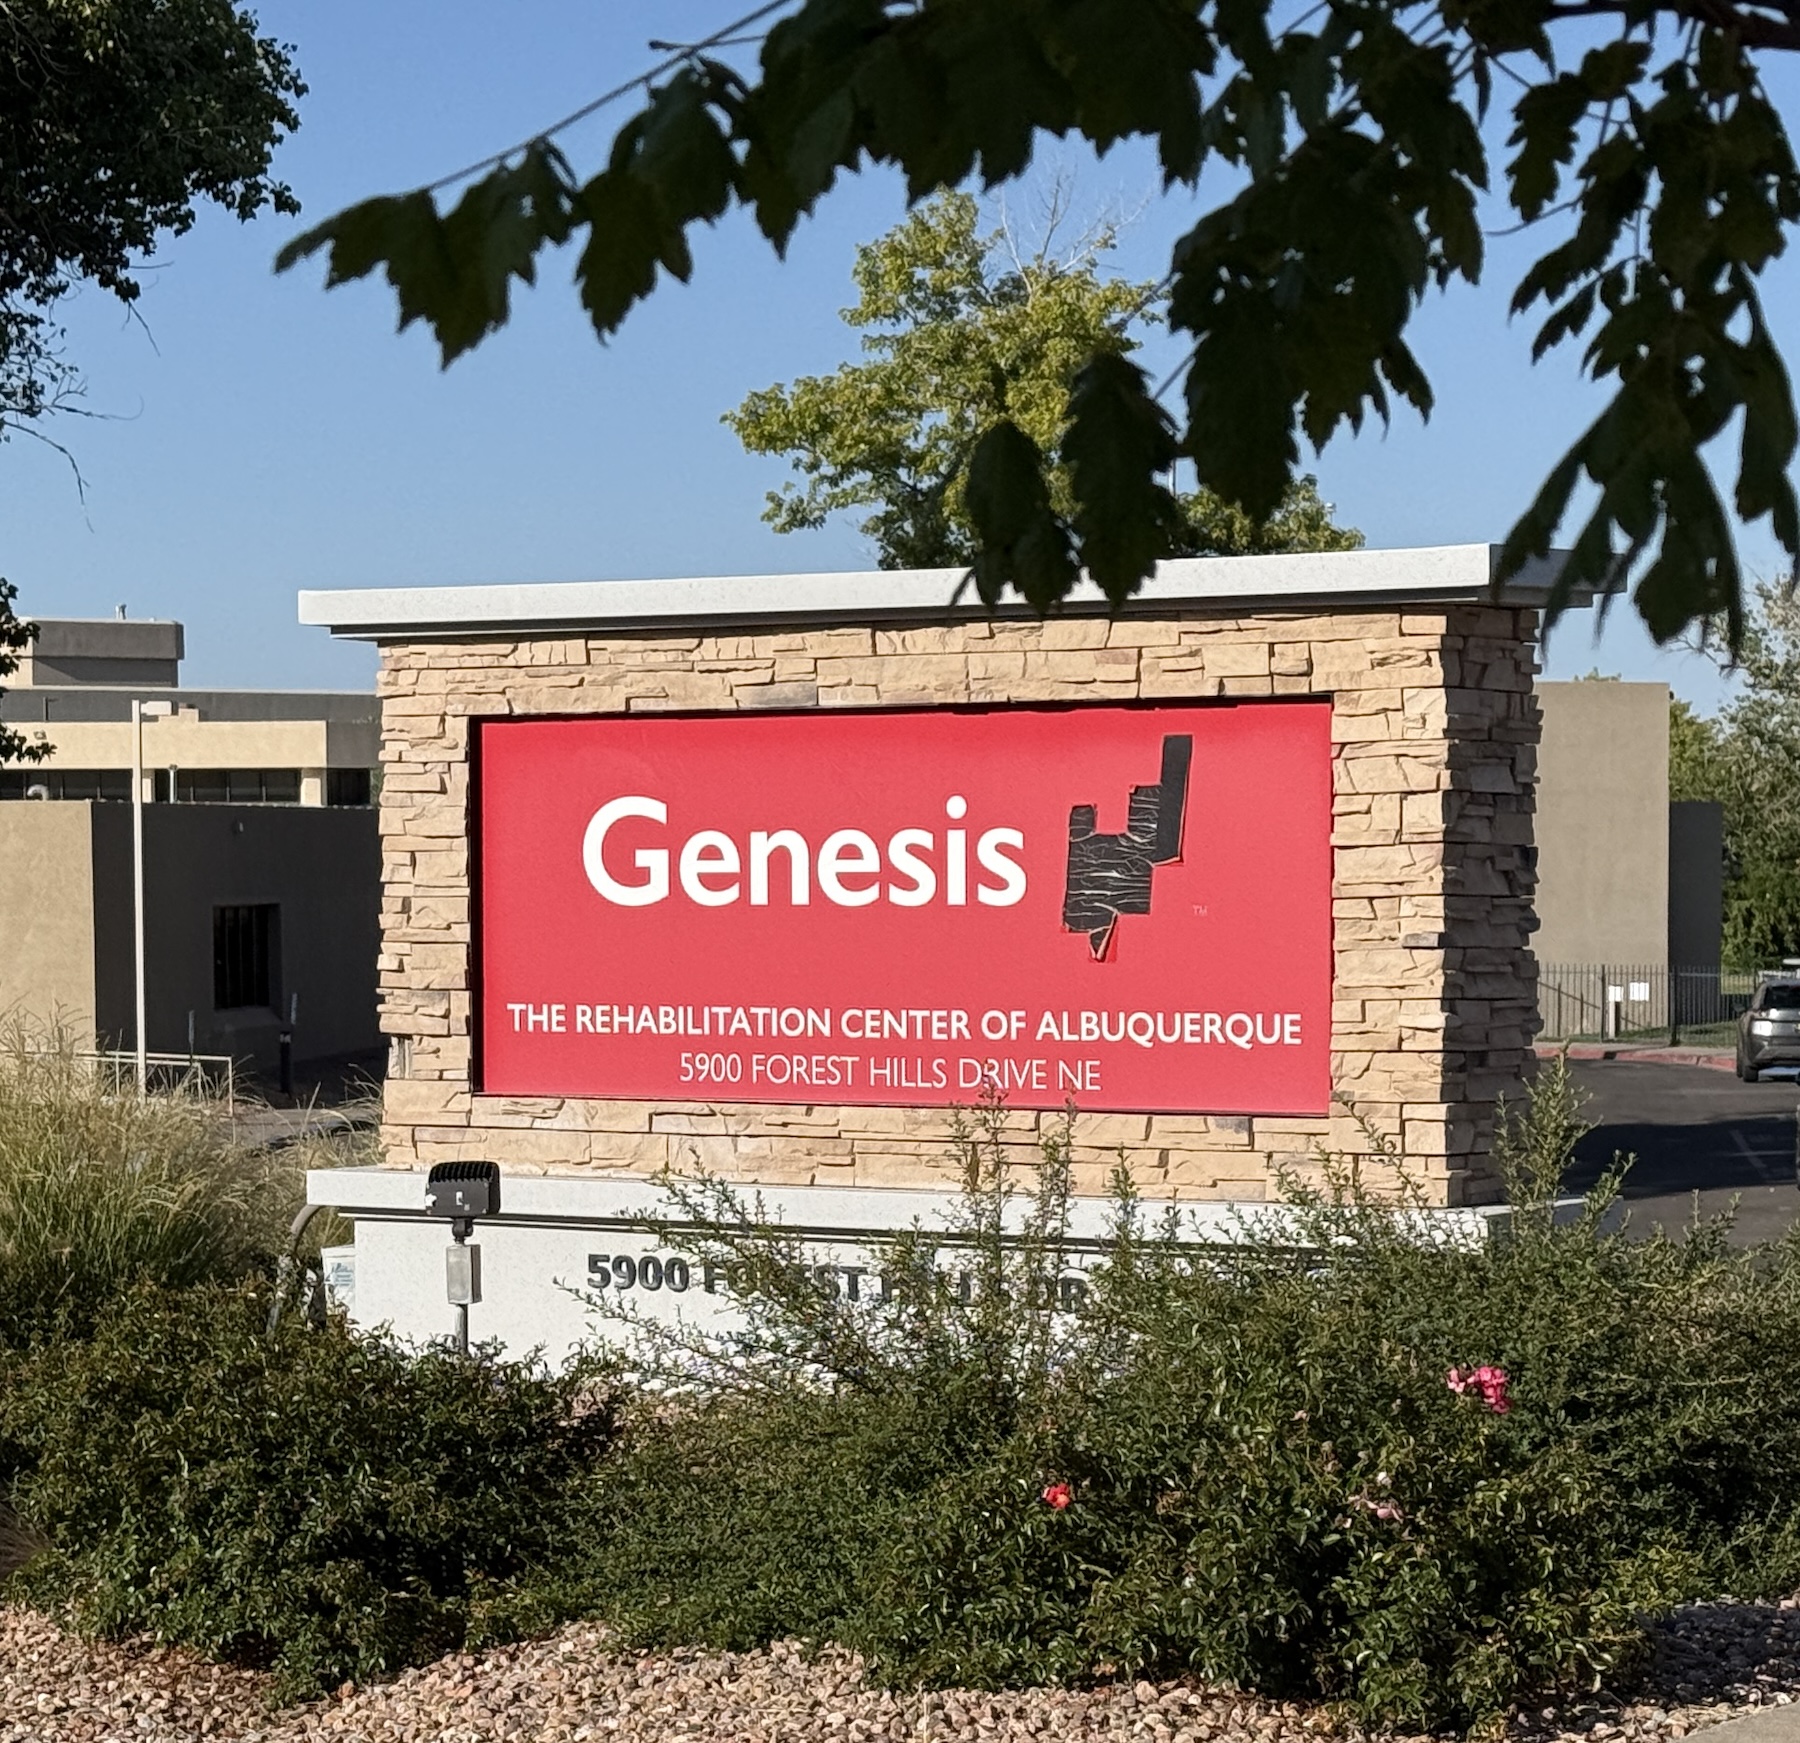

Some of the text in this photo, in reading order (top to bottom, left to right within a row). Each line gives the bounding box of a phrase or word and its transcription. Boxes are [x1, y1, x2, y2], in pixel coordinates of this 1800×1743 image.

[582, 795, 1027, 907] Genesis
[506, 1003, 1302, 1050] THE REHABILITATION CENTER OF ALBUQUERQUE
[680, 1052, 1101, 1091] 5900 FOREST HILLS DRIVE NE
[587, 1253, 690, 1293] 5900
[704, 1261, 868, 1302] FST
